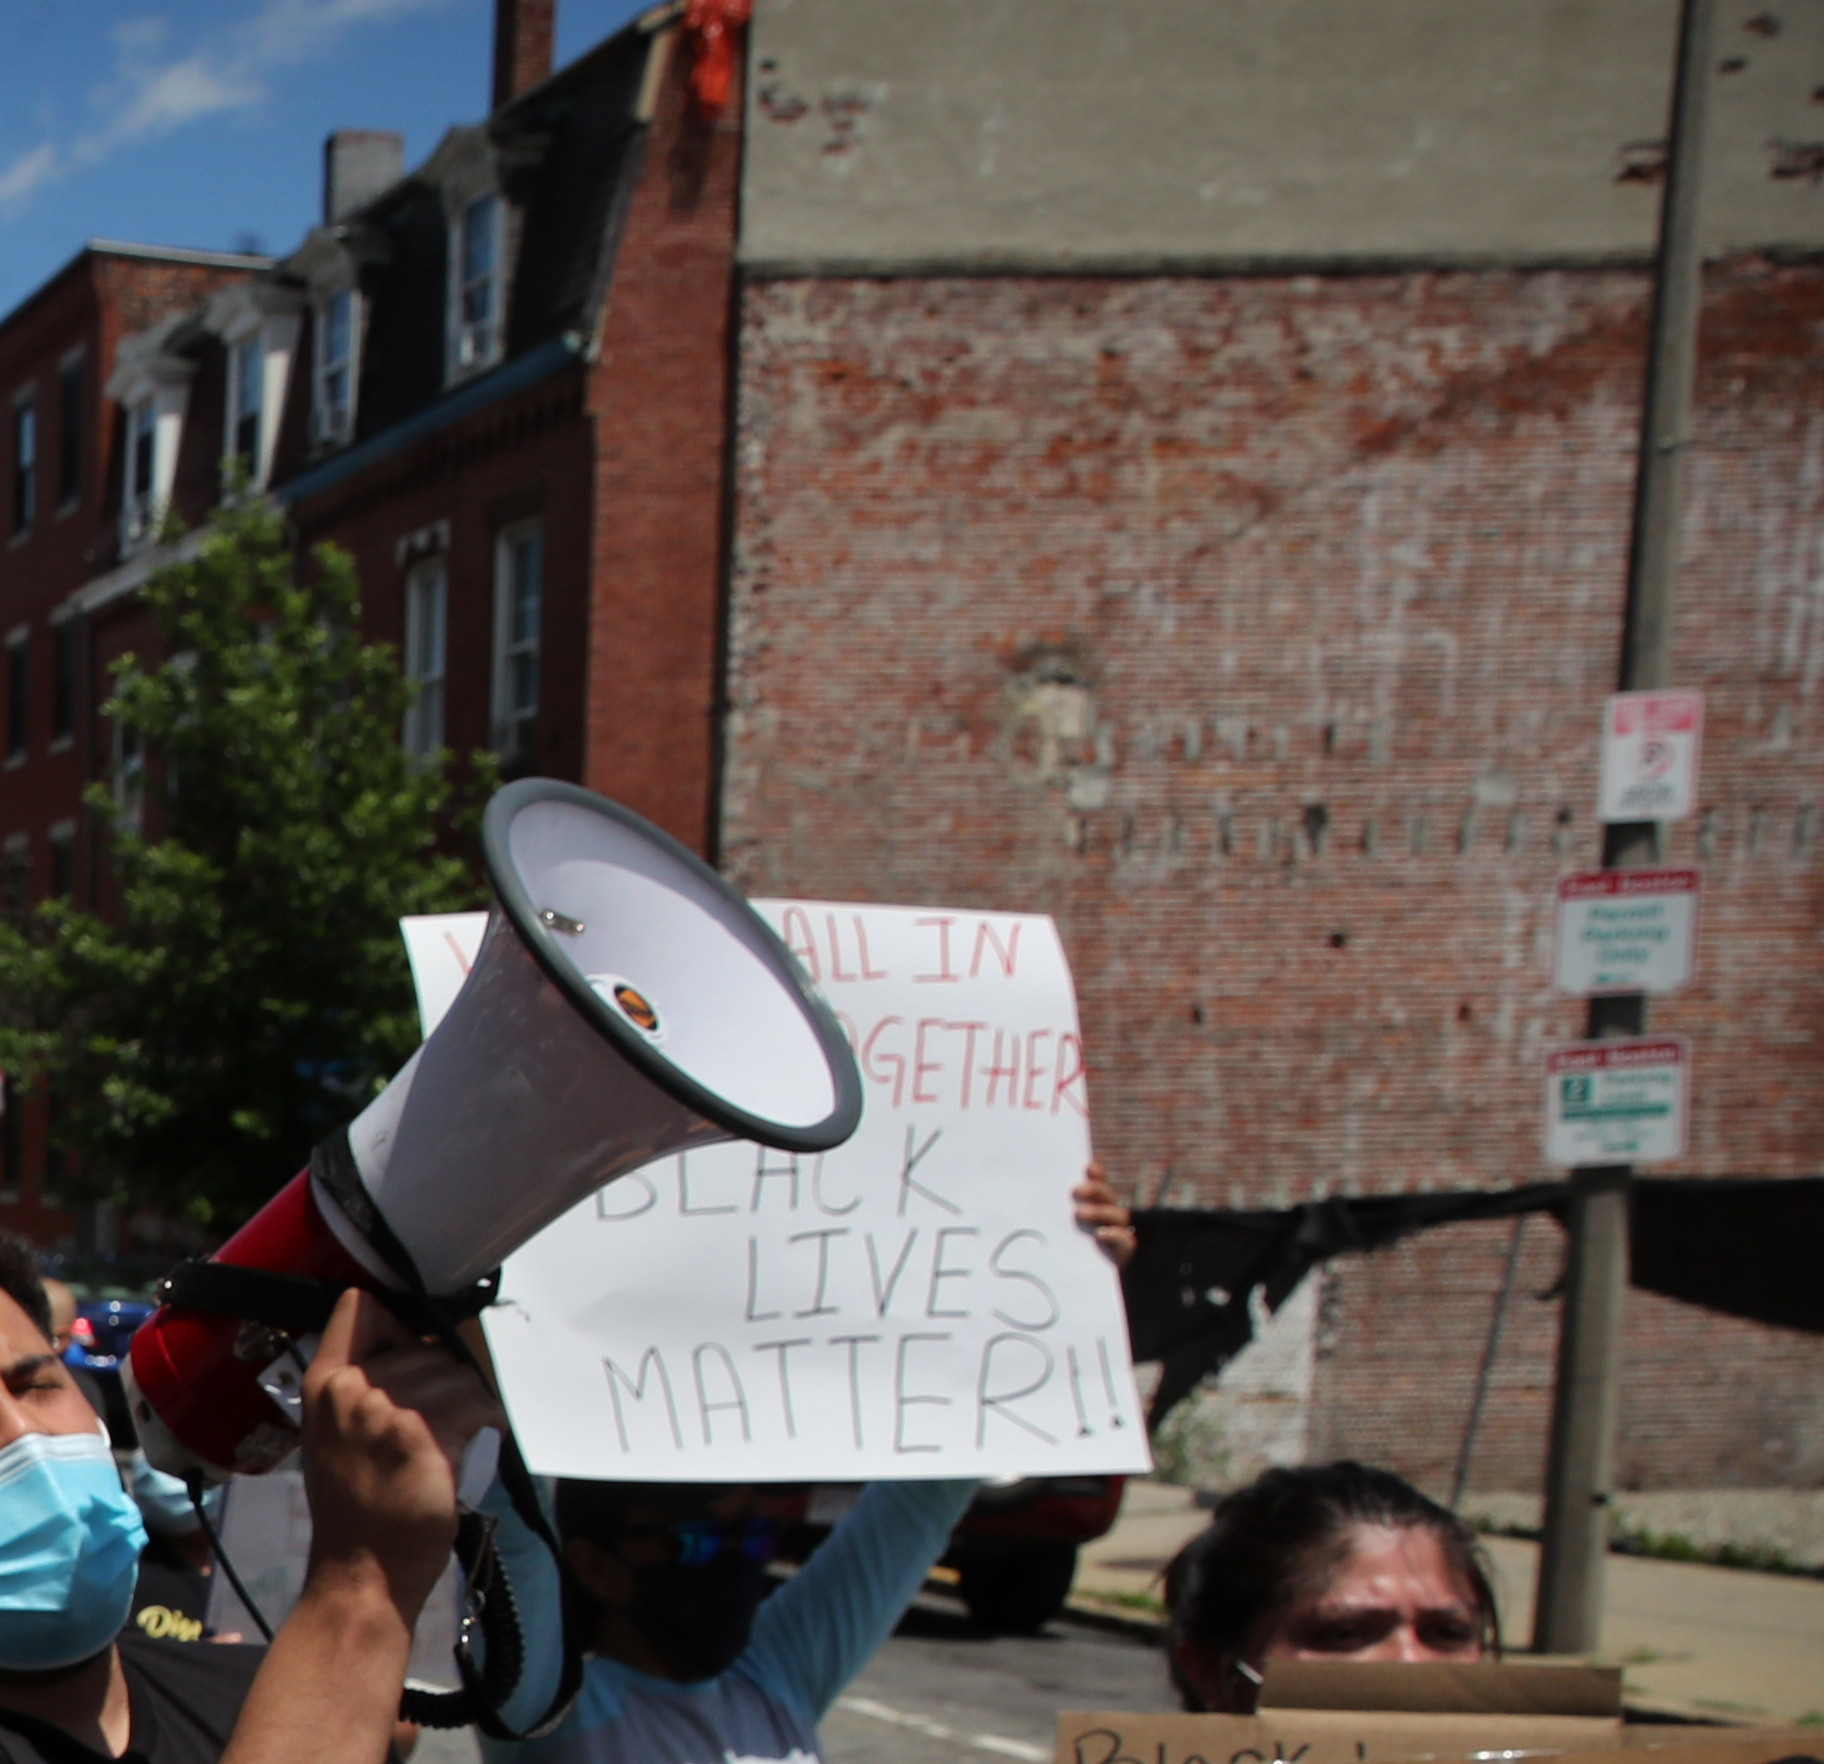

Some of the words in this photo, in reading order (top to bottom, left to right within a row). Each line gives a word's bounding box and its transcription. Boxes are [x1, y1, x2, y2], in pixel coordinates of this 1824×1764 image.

[782, 905, 890, 985] ALL
[910, 914, 1023, 984] IN
[836, 1011, 1089, 1118] GETHER
[595, 1122, 963, 1222] BLACK
[746, 1226, 1060, 1333] LIVES
[603, 1330, 1127, 1455] MATTER!!
